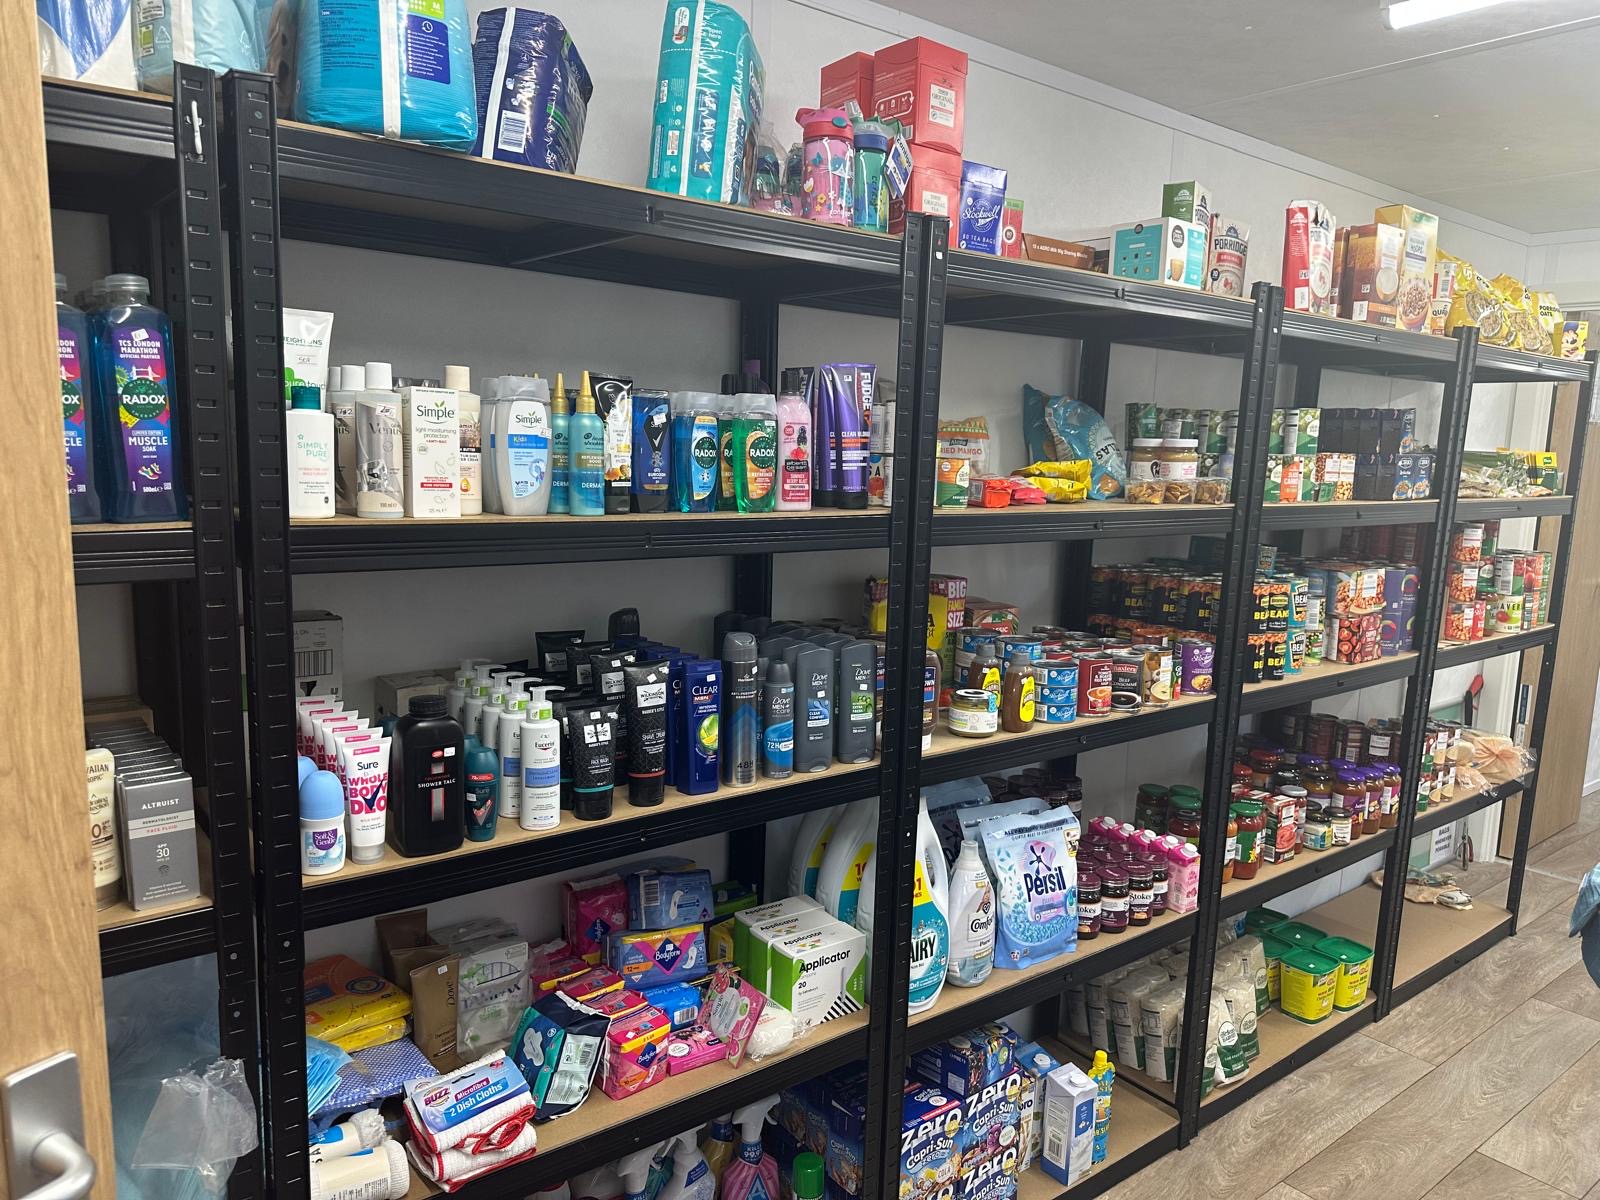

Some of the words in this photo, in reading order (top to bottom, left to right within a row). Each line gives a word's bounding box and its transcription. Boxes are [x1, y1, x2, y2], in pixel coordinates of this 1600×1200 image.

[963, 205, 1001, 220] Stockwell
[1214, 238, 1248, 256] PORRIDGE
[133, 340, 161, 348] LONDON
[860, 372, 872, 411] FUDGE
[122, 394, 166, 405] RADOX
[416, 405, 454, 420] Simple
[515, 414, 542, 425] Simple
[128, 437, 168, 446] MUSCLE
[297, 441, 328, 449] SIMPLY
[694, 449, 717, 458] RADOX
[750, 448, 775, 457] RADOX
[958, 447, 983, 455] MANGO
[948, 581, 967, 599] BIG
[948, 600, 966, 611] FAMILY
[1125, 598, 1144, 607] BEA
[947, 612, 964, 629] SIZE
[1268, 657, 1286, 666] BEA
[1113, 664, 1138, 673] axters
[640, 690, 665, 698] WILKINSON
[692, 685, 718, 695] CLEAR
[535, 740, 555, 748] Eucerin
[767, 741, 780, 749] 72H
[87, 763, 109, 774] AIIAN
[357, 761, 379, 771] Sure
[349, 772, 388, 785] WHOLE
[350, 782, 388, 798] BODY
[418, 781, 442, 789] SHOWER
[141, 799, 180, 810] ALTRUIST
[142, 815, 179, 825] DERMATOLOGIST
[314, 832, 328, 840] Soft
[315, 838, 336, 846] Gentle
[156, 848, 170, 858] 30
[1024, 866, 1067, 902] Persil
[1129, 892, 1152, 901] Stokes
[745, 903, 783, 915] Applicator
[760, 918, 799, 931] Applicator
[783, 931, 822, 946] Applicator
[910, 935, 936, 962] AIRY
[655, 949, 681, 962] Bodyform
[799, 950, 850, 974] Applicator
[798, 981, 807, 989] 20
[456, 1081, 487, 1099] Microfibre
[424, 1087, 450, 1105] BUZZ
[450, 1108, 456, 1116] 2
[457, 1098, 476, 1113] Dish
[476, 1083, 502, 1100] Cloths
[973, 1102, 1014, 1132] Capri-Sun
[906, 1138, 953, 1169] Capri-Sun
